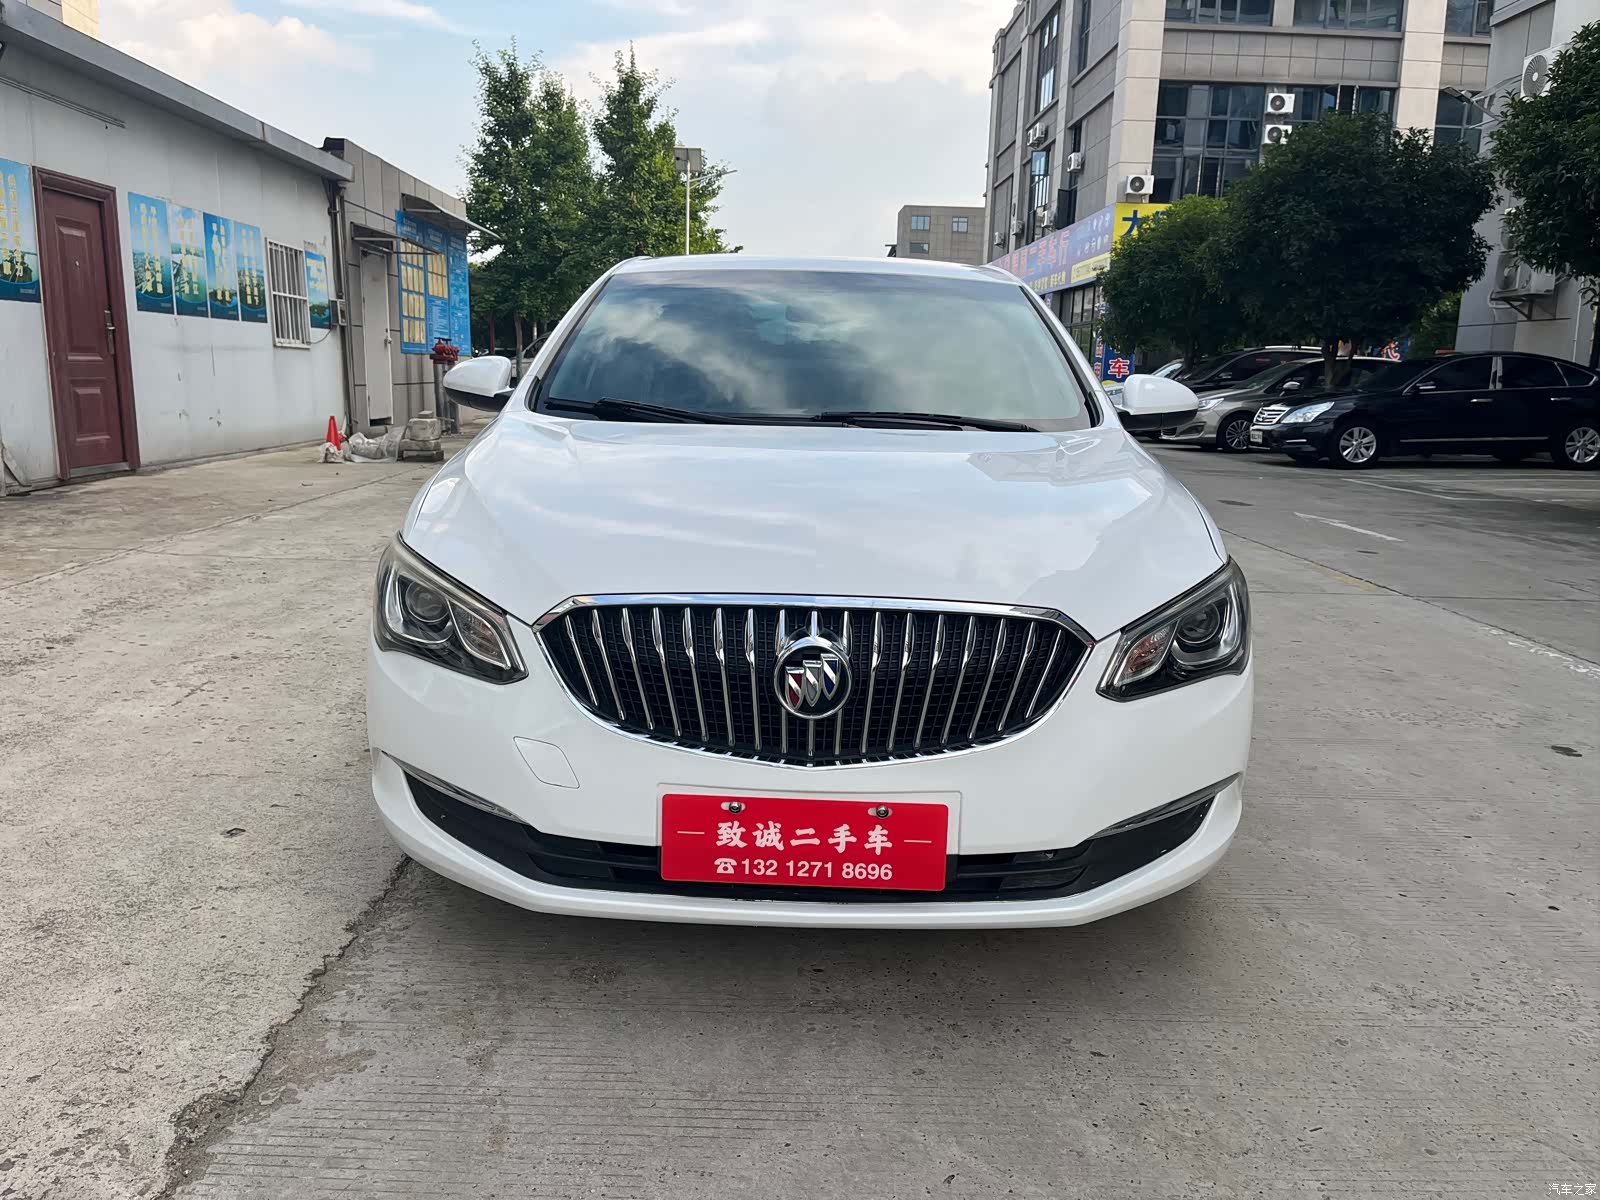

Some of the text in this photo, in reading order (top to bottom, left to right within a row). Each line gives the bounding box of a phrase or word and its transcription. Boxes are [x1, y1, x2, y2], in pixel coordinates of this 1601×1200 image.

[715, 820, 893, 856] 致诚二手车
[741, 858, 893, 881] 132 1271 8696
